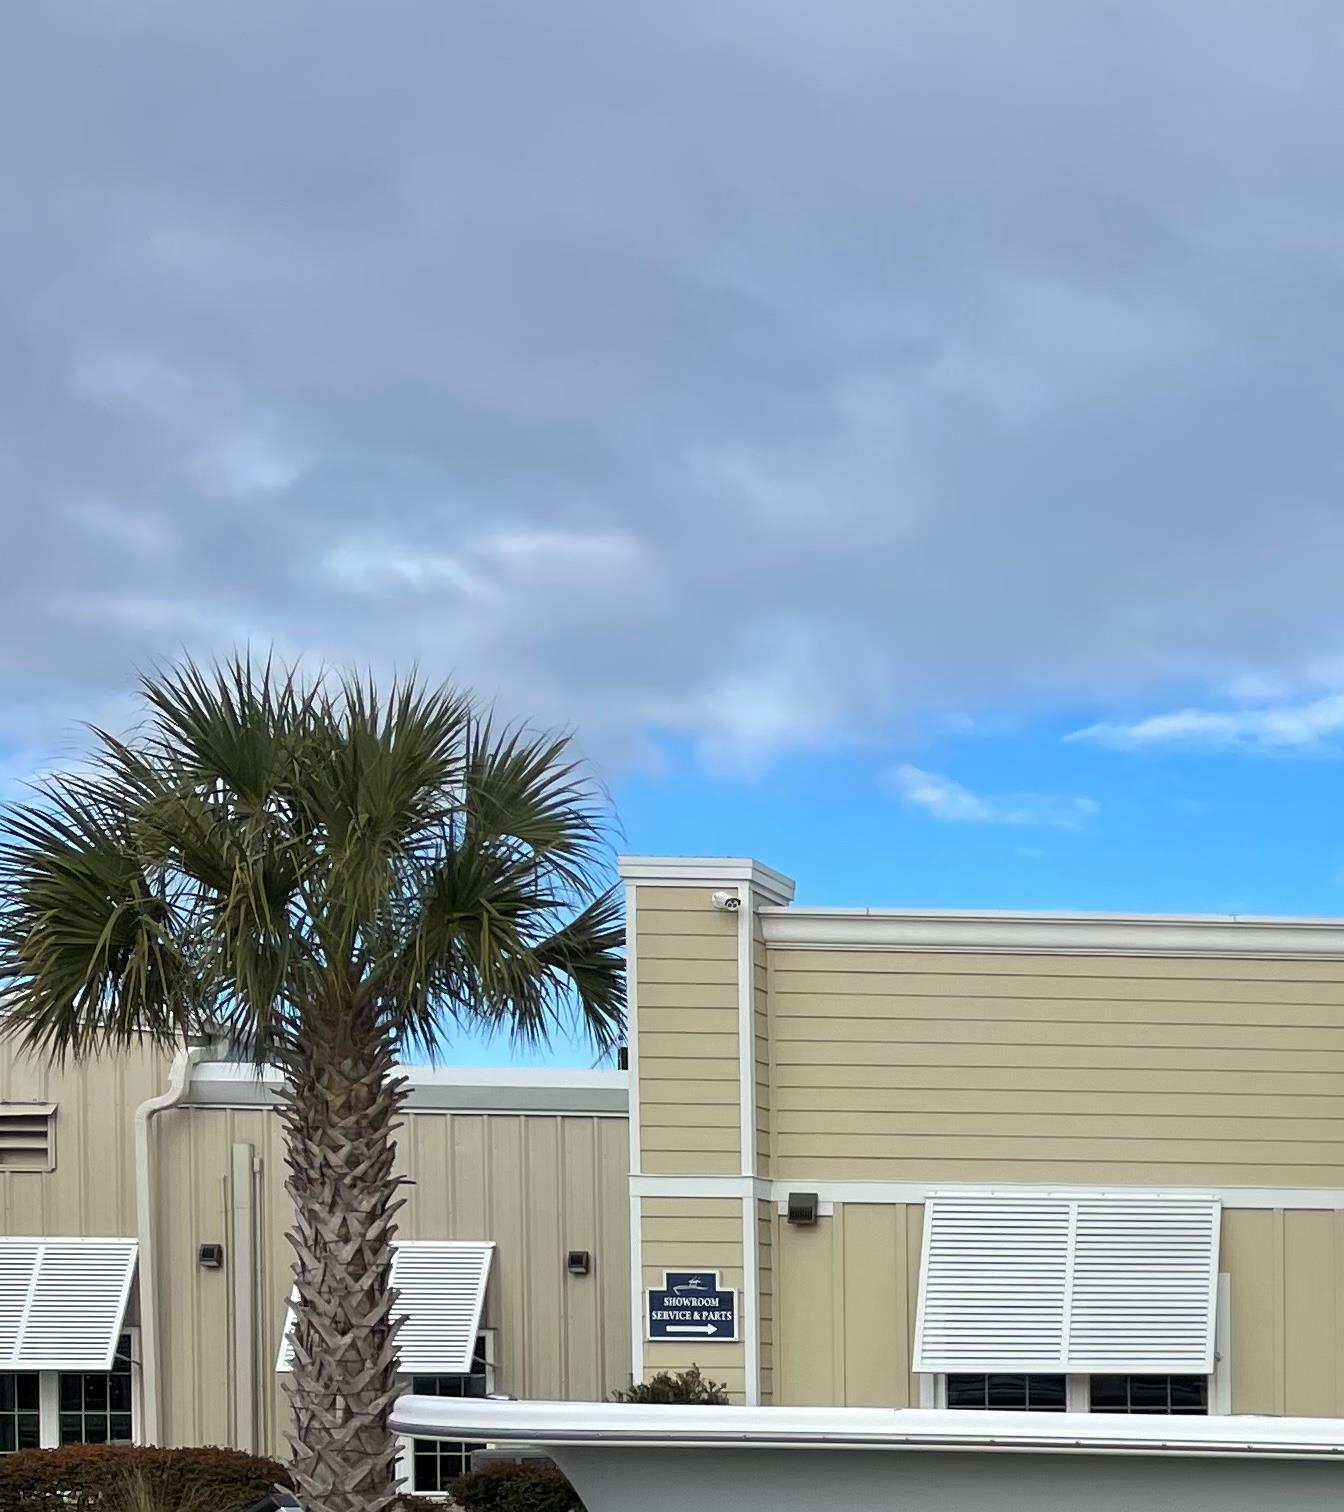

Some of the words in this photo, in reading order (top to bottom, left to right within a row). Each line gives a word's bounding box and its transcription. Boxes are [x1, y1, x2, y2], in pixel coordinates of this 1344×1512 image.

[663, 1297, 720, 1307] SHOWROOM
[652, 1311, 691, 1320] SERVICE
[693, 1311, 700, 1320] &
[702, 1311, 732, 1321] PARTS
